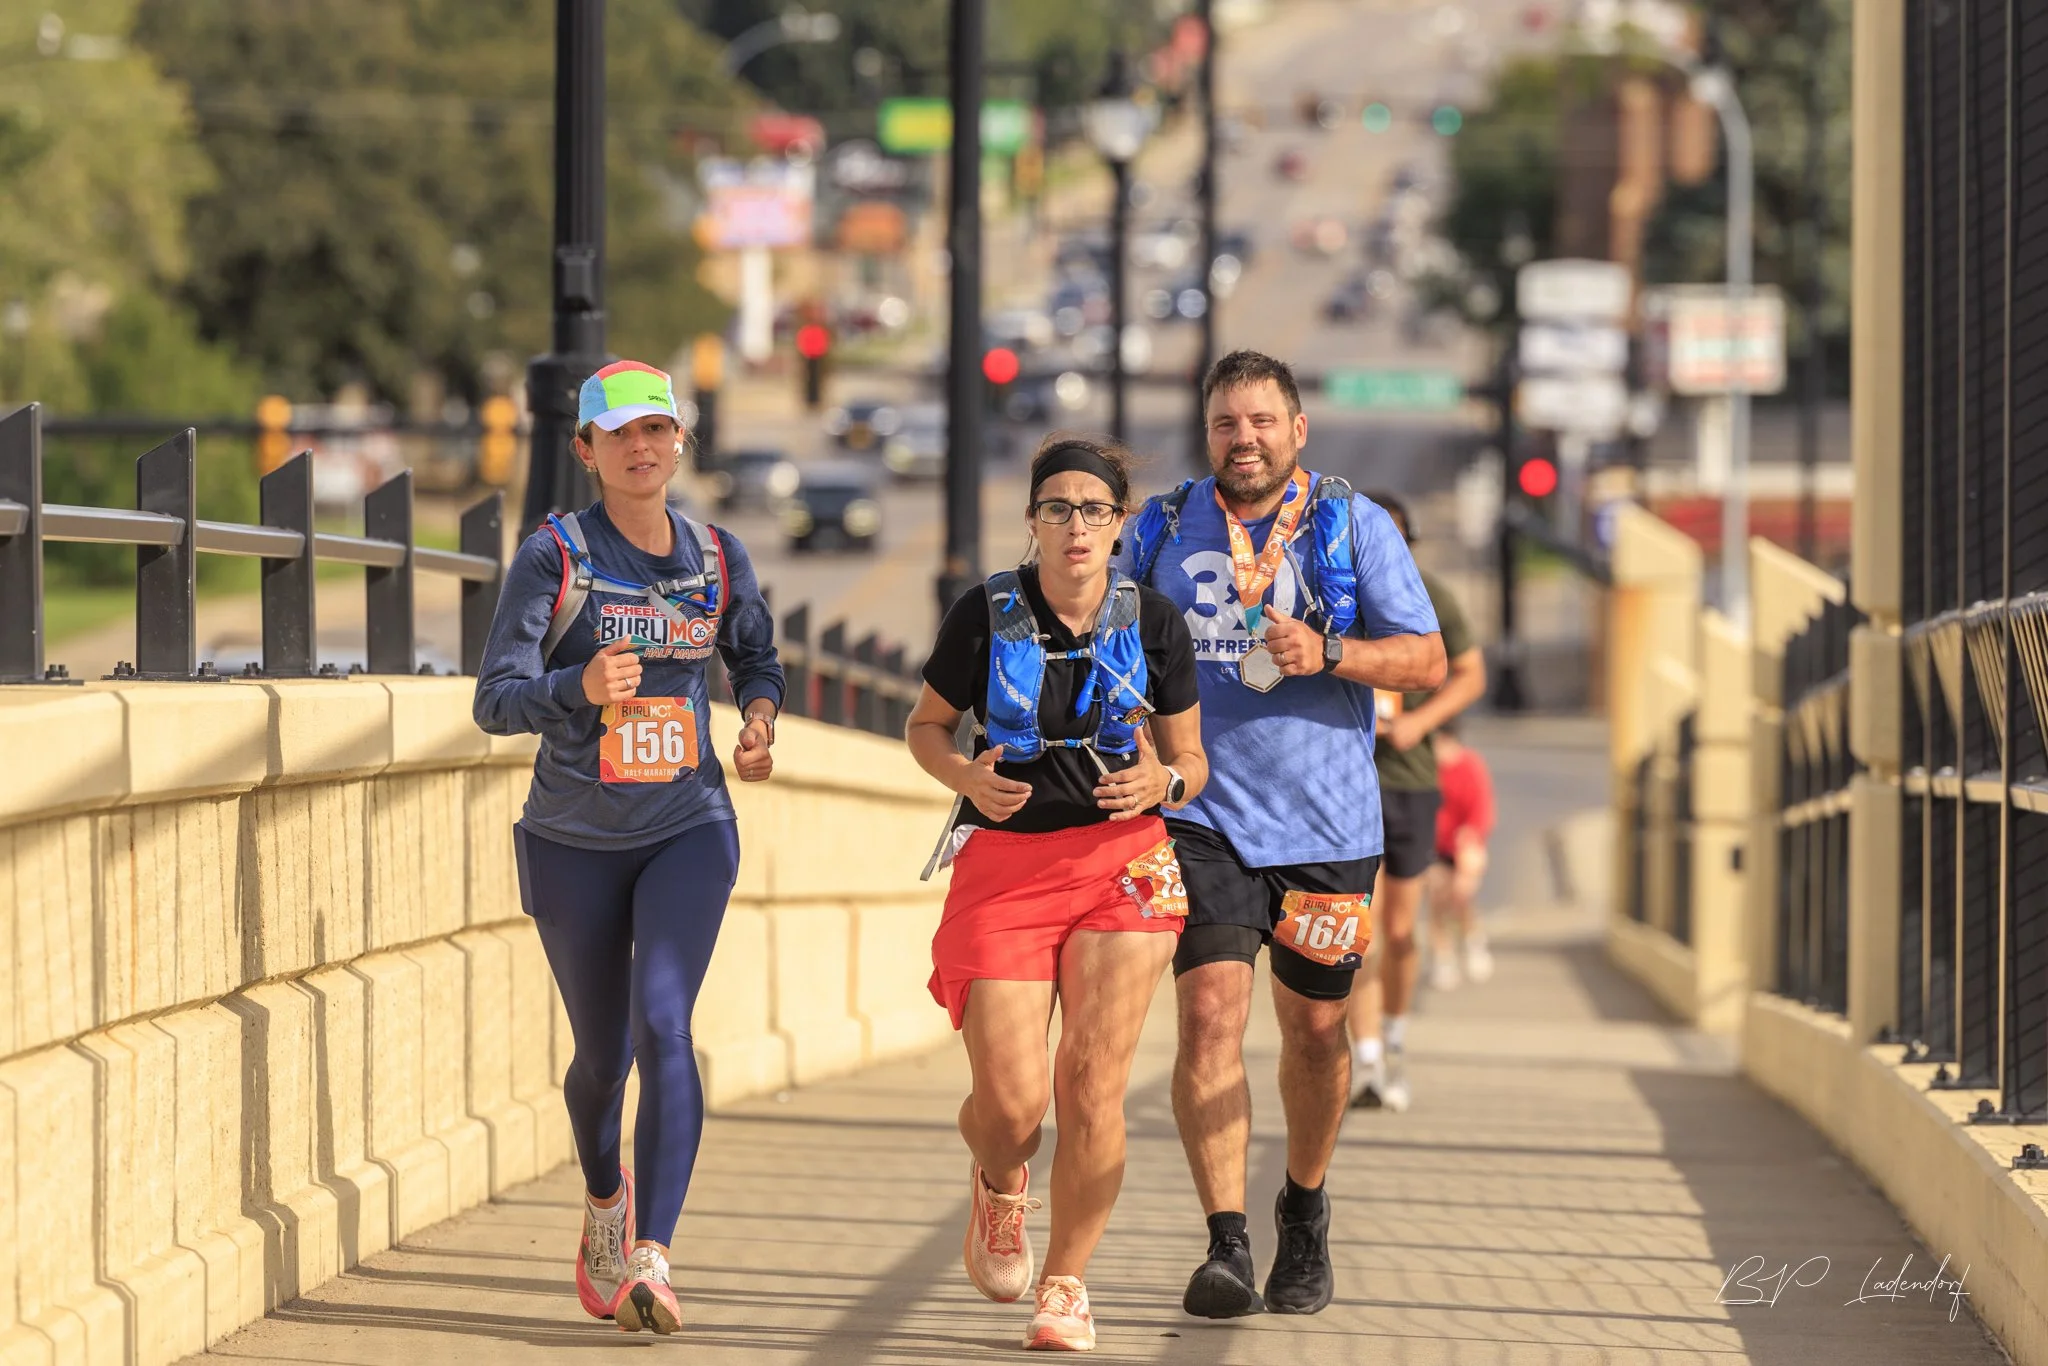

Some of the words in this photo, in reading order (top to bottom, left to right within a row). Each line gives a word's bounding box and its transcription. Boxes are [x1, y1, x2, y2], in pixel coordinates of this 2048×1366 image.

[694, 627, 706, 638] 26
[1193, 639, 1211, 653] OR
[644, 647, 673, 658] HALF
[616, 720, 685, 764] 156
[624, 768, 642, 777] HALF
[643, 768, 680, 777] MARATHON
[1293, 913, 1359, 950] 164
